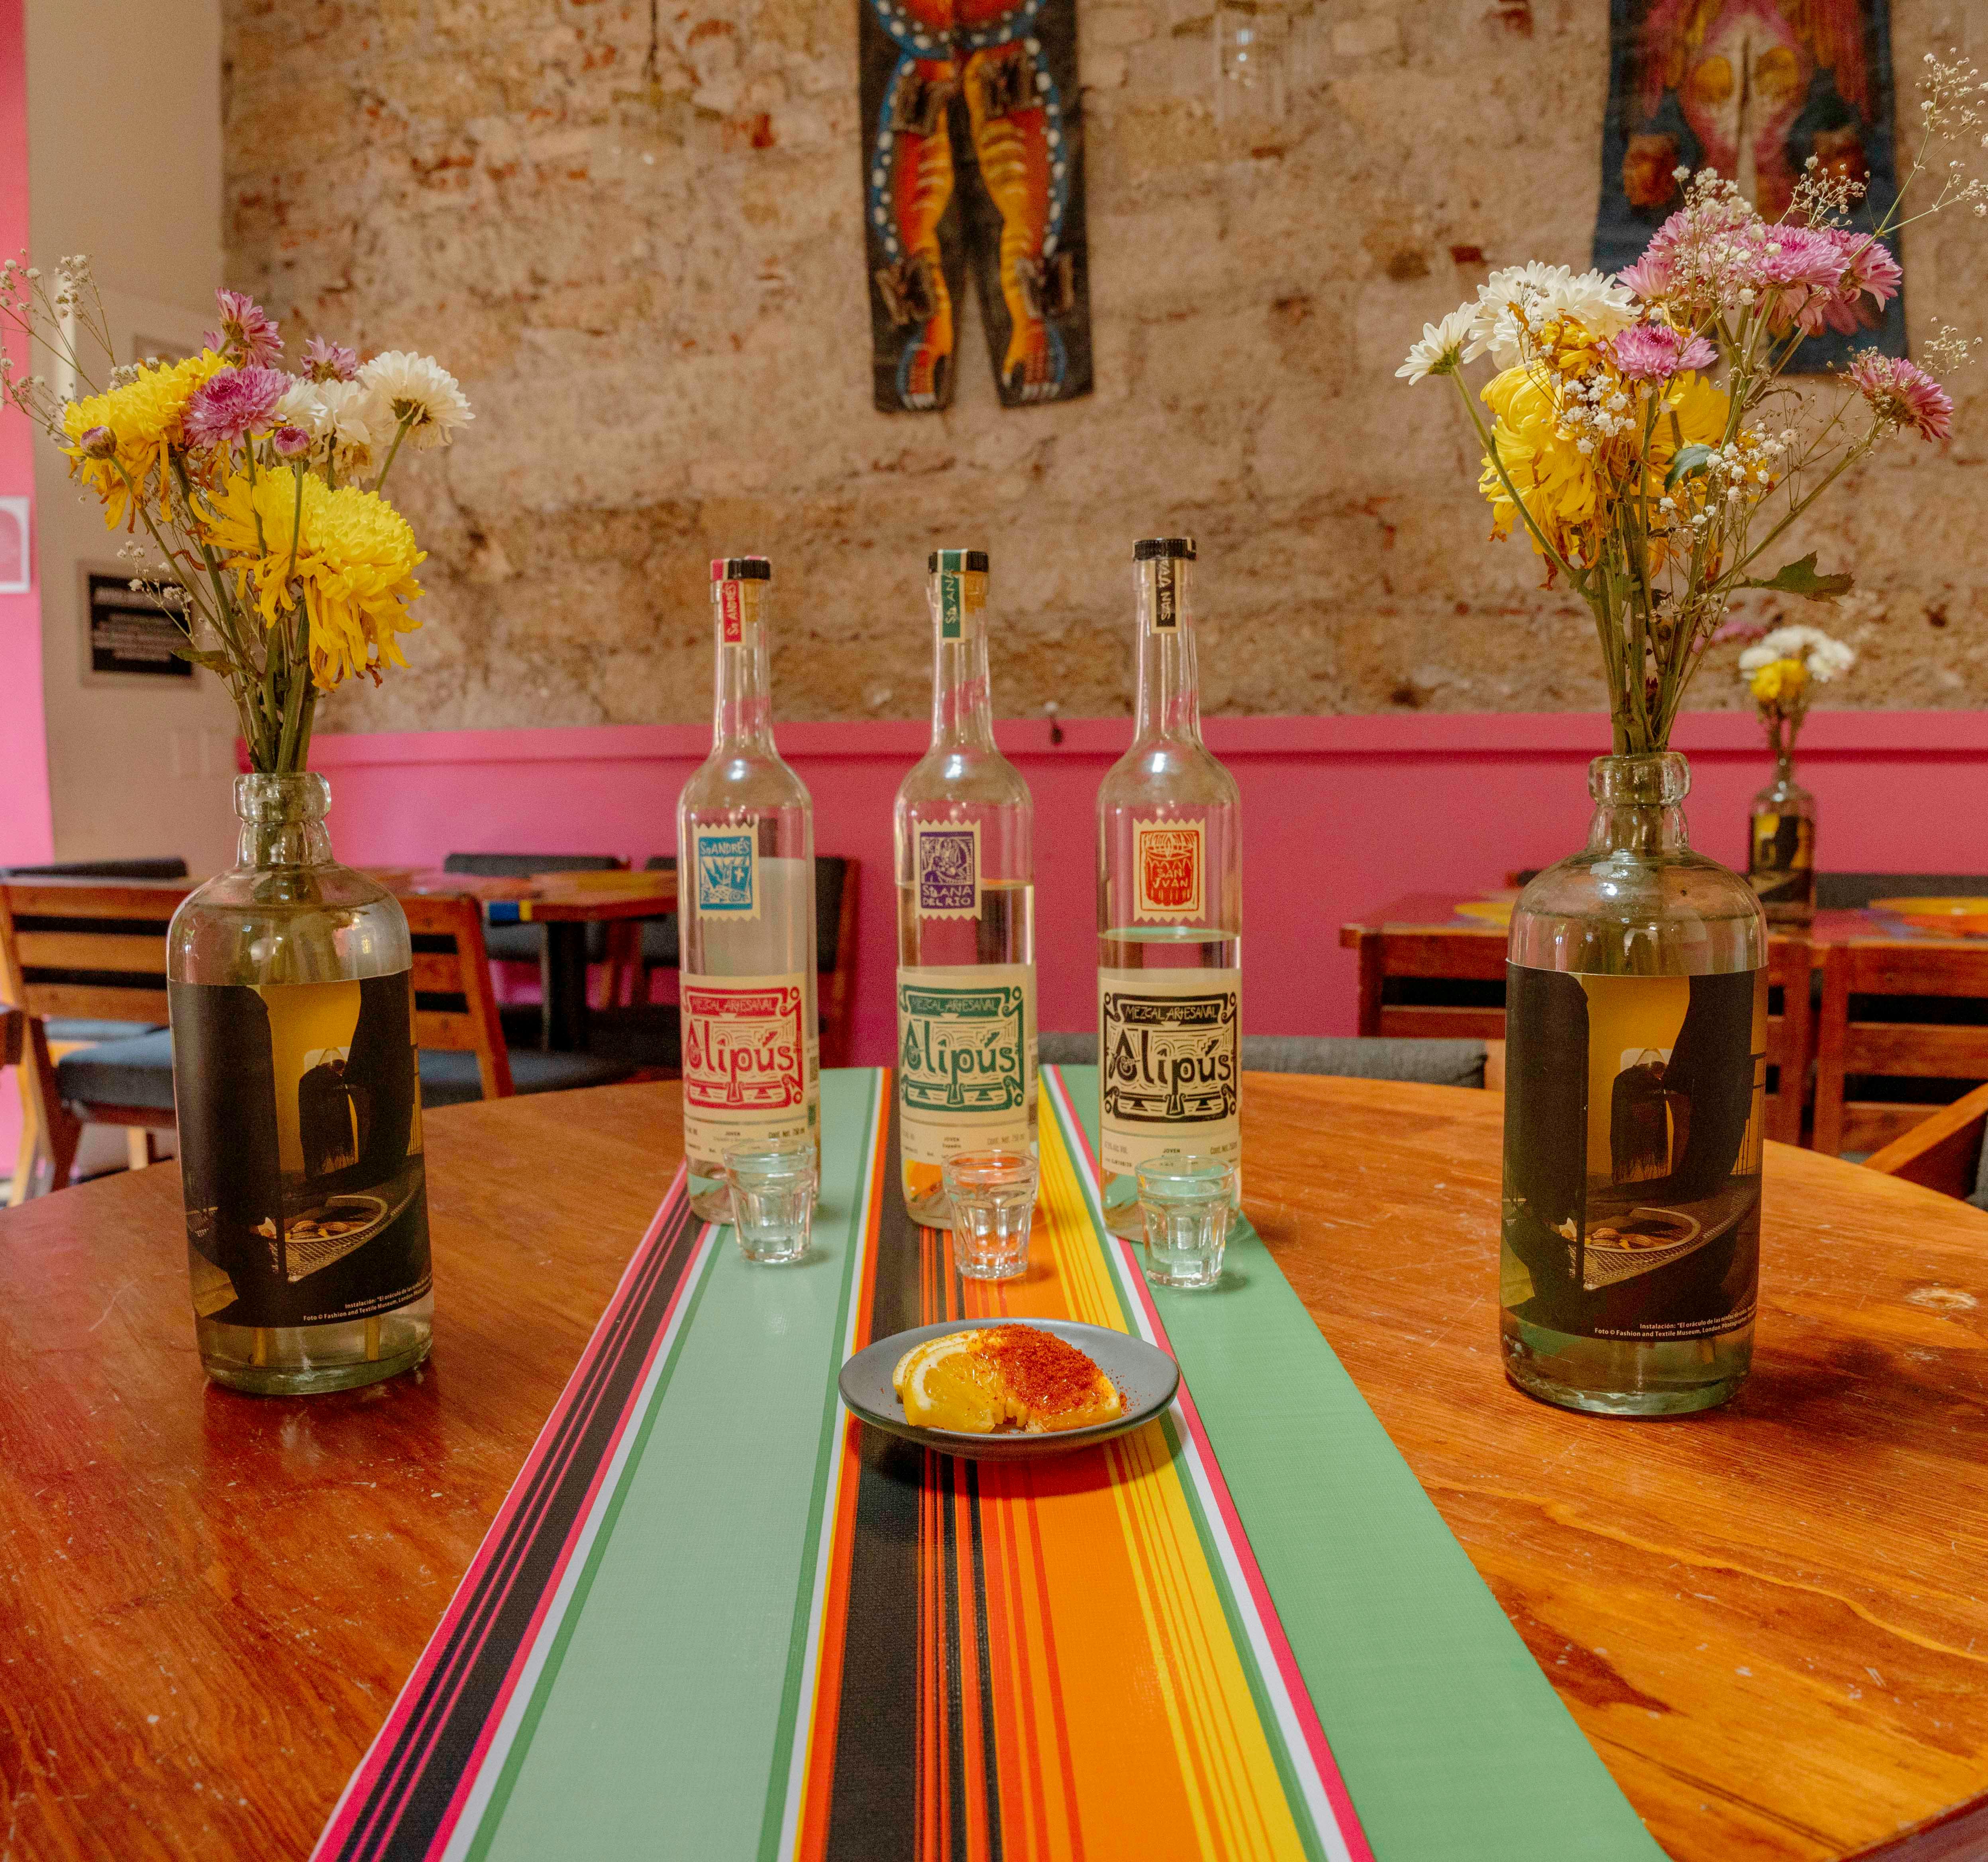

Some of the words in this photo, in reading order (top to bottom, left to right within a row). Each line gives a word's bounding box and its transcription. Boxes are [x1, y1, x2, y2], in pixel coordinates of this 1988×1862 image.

[1160, 591, 1172, 621] SAN
[1156, 867, 1182, 878] SAN
[938, 885, 973, 896] ANA
[1125, 1005, 1165, 1021] MEZCAL
[1165, 1005, 1216, 1021] ARTESANAL
[684, 1019, 794, 1083] Alipús
[902, 1019, 1016, 1085] Alipús
[1108, 1029, 1231, 1095] Alipús
[345, 1298, 377, 1309] Instalación:
[359, 1304, 377, 1314] Textile
